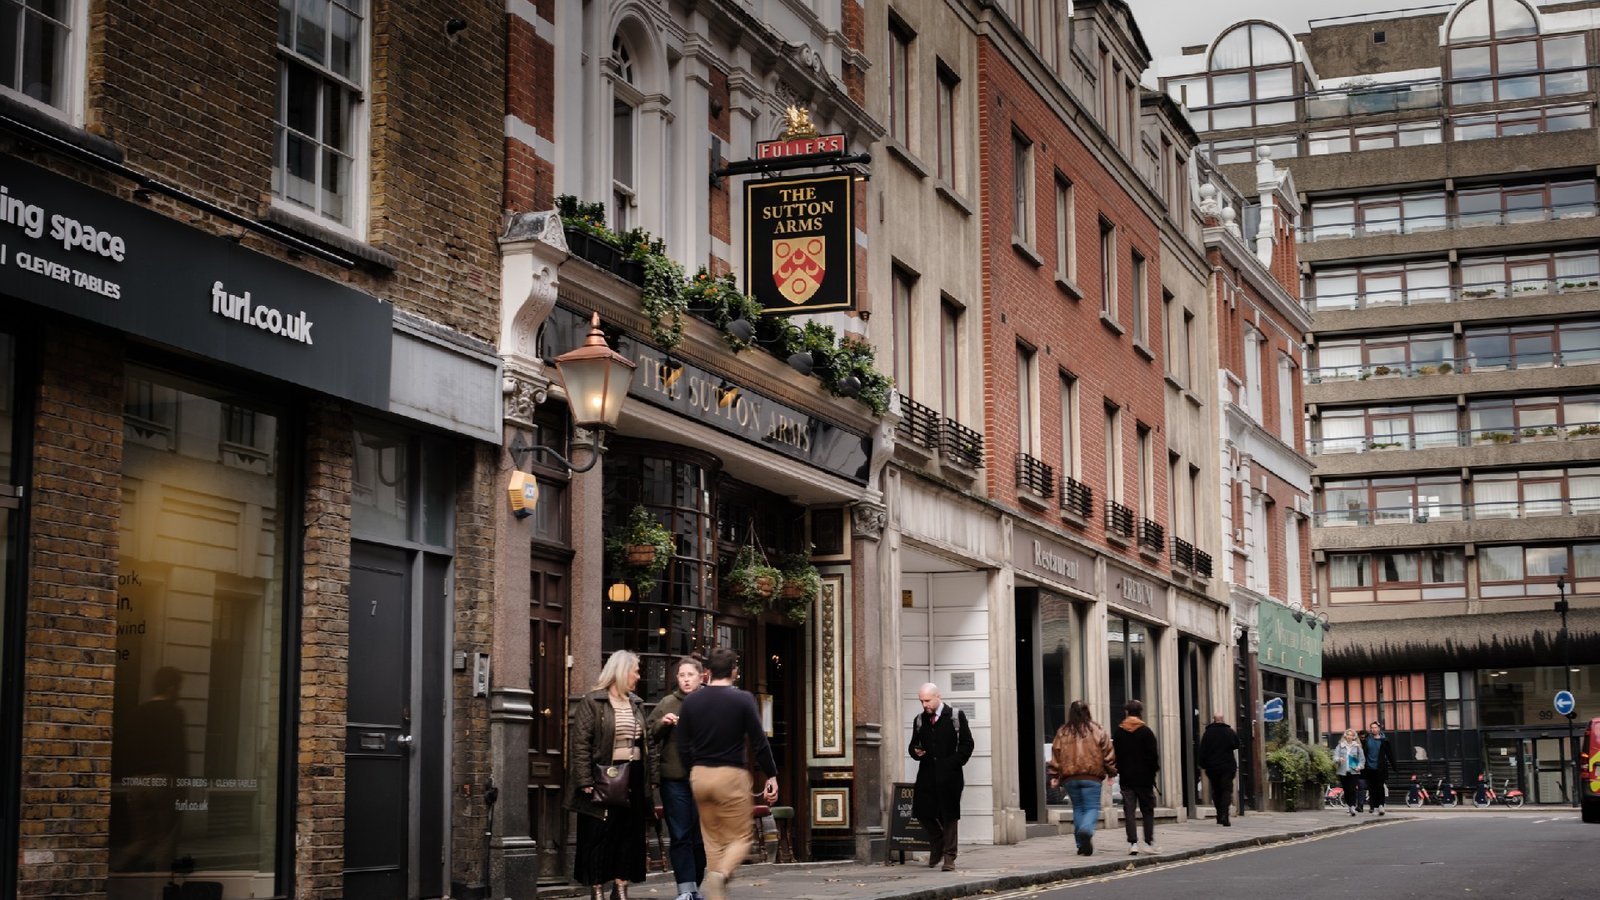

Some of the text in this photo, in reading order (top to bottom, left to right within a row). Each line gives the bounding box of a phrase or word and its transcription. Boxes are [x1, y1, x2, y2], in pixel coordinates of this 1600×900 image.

[762, 138, 838, 158] FULLER'S
[779, 187, 816, 202] THE
[762, 201, 834, 219] SUTTON
[773, 217, 823, 234] ARMS
[50, 214, 125, 262] space
[16, 252, 120, 299] CLEVER TABLES
[212, 280, 313, 345] furl.co.uk
[640, 354, 811, 452] THE SUTTON ARMS
[1034, 539, 1079, 579] Restaurant
[371, 600, 377, 615] 7
[1539, 710, 1553, 720] 99
[121, 777, 151, 787] STORAGE
[151, 777, 168, 787] BEDS
[176, 778, 191, 788] SOFA
[192, 778, 208, 788] BEDS
[175, 799, 208, 811] furl.co.uk
